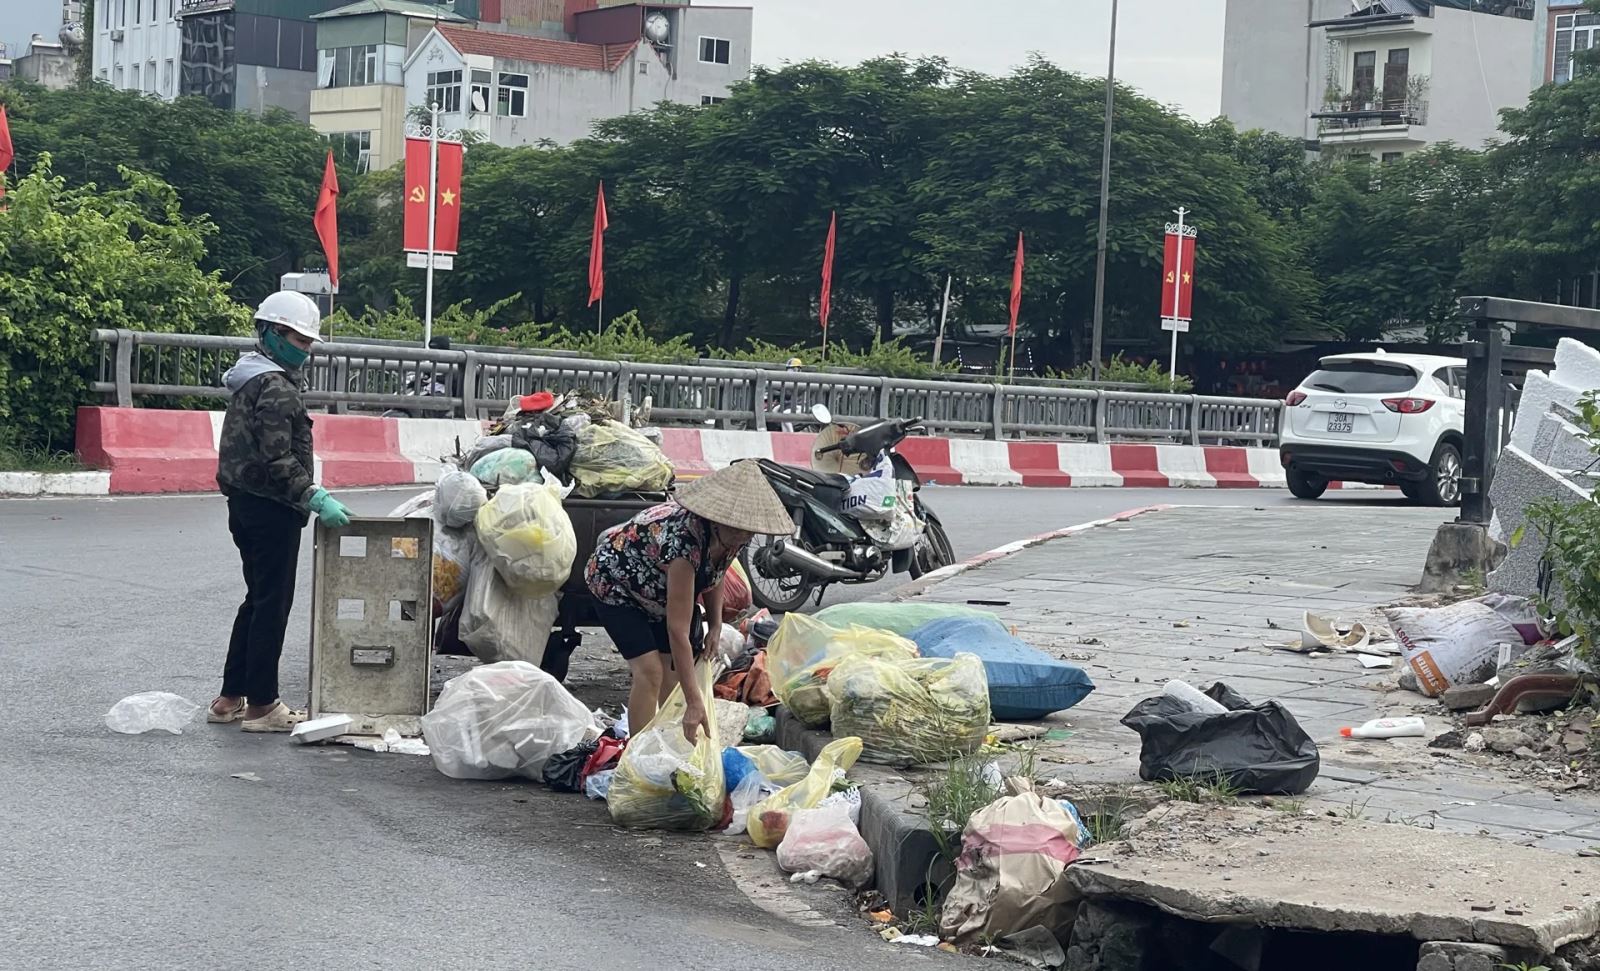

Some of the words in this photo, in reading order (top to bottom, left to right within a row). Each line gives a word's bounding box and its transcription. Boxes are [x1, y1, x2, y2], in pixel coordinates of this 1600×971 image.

[1334, 414, 1347, 422] 30A
[1328, 422, 1352, 431] 23375
[1416, 655, 1439, 687] STARTER
